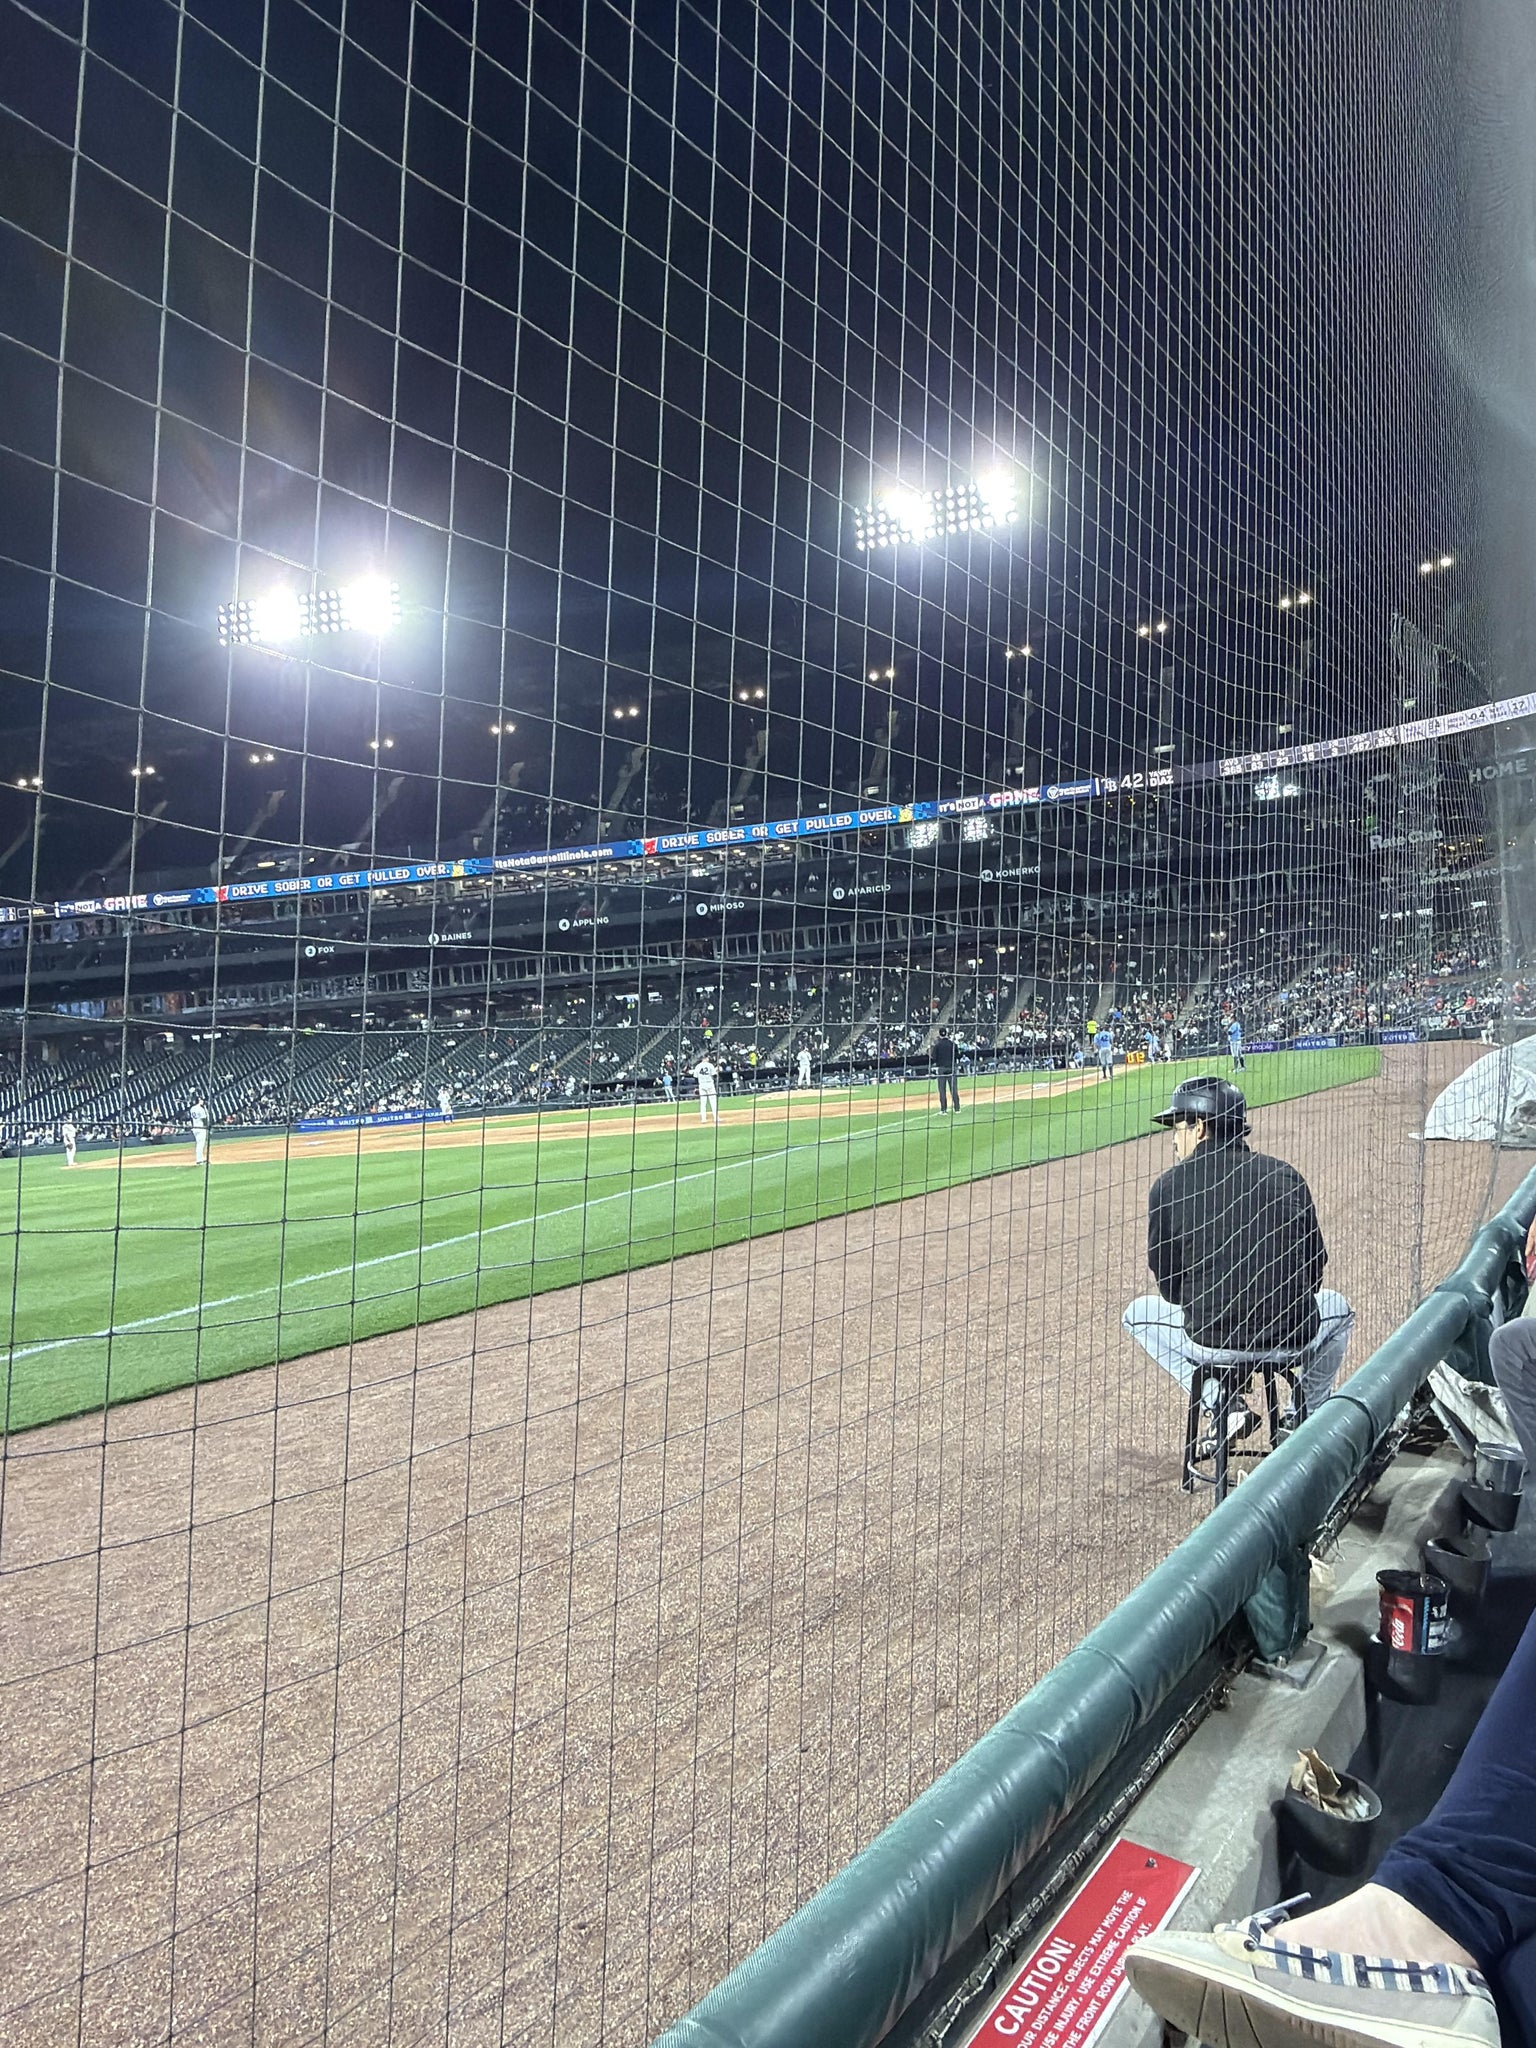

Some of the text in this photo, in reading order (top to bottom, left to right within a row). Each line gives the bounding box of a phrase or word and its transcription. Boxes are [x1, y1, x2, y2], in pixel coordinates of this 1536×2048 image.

[1120, 773, 1144, 788] 42
[979, 799, 986, 807] A
[989, 788, 1040, 808] GAME
[661, 811, 897, 848] DRIVE SOBER OR GET PULLED OVER.
[232, 864, 450, 897] DRIVE SOBER OR GET PULLED OVER.
[995, 865, 1041, 879] KONERKO
[847, 884, 891, 896] APARICIO
[103, 895, 148, 911] GAME
[572, 917, 609, 928] APPLING
[318, 946, 335, 954] FOX
[700, 1067, 709, 1075] 42
[1064, 1946, 1094, 1983] OBJECTS
[1089, 1927, 1106, 1947] MAY
[1102, 1905, 1123, 1929] MOVE
[1117, 1890, 1133, 1907] THE
[1053, 1997, 1084, 2031] INJURY.
[1077, 1976, 1096, 1995] USE
[1090, 1939, 1120, 1976] EXTREME
[1114, 1906, 1142, 1939] CAUTION
[1136, 1896, 1147, 1908] IF
[994, 1936, 1077, 2036] CAUTION!
[1076, 1998, 1102, 2031] FRONT
[1096, 1977, 1117, 2000] ROW
